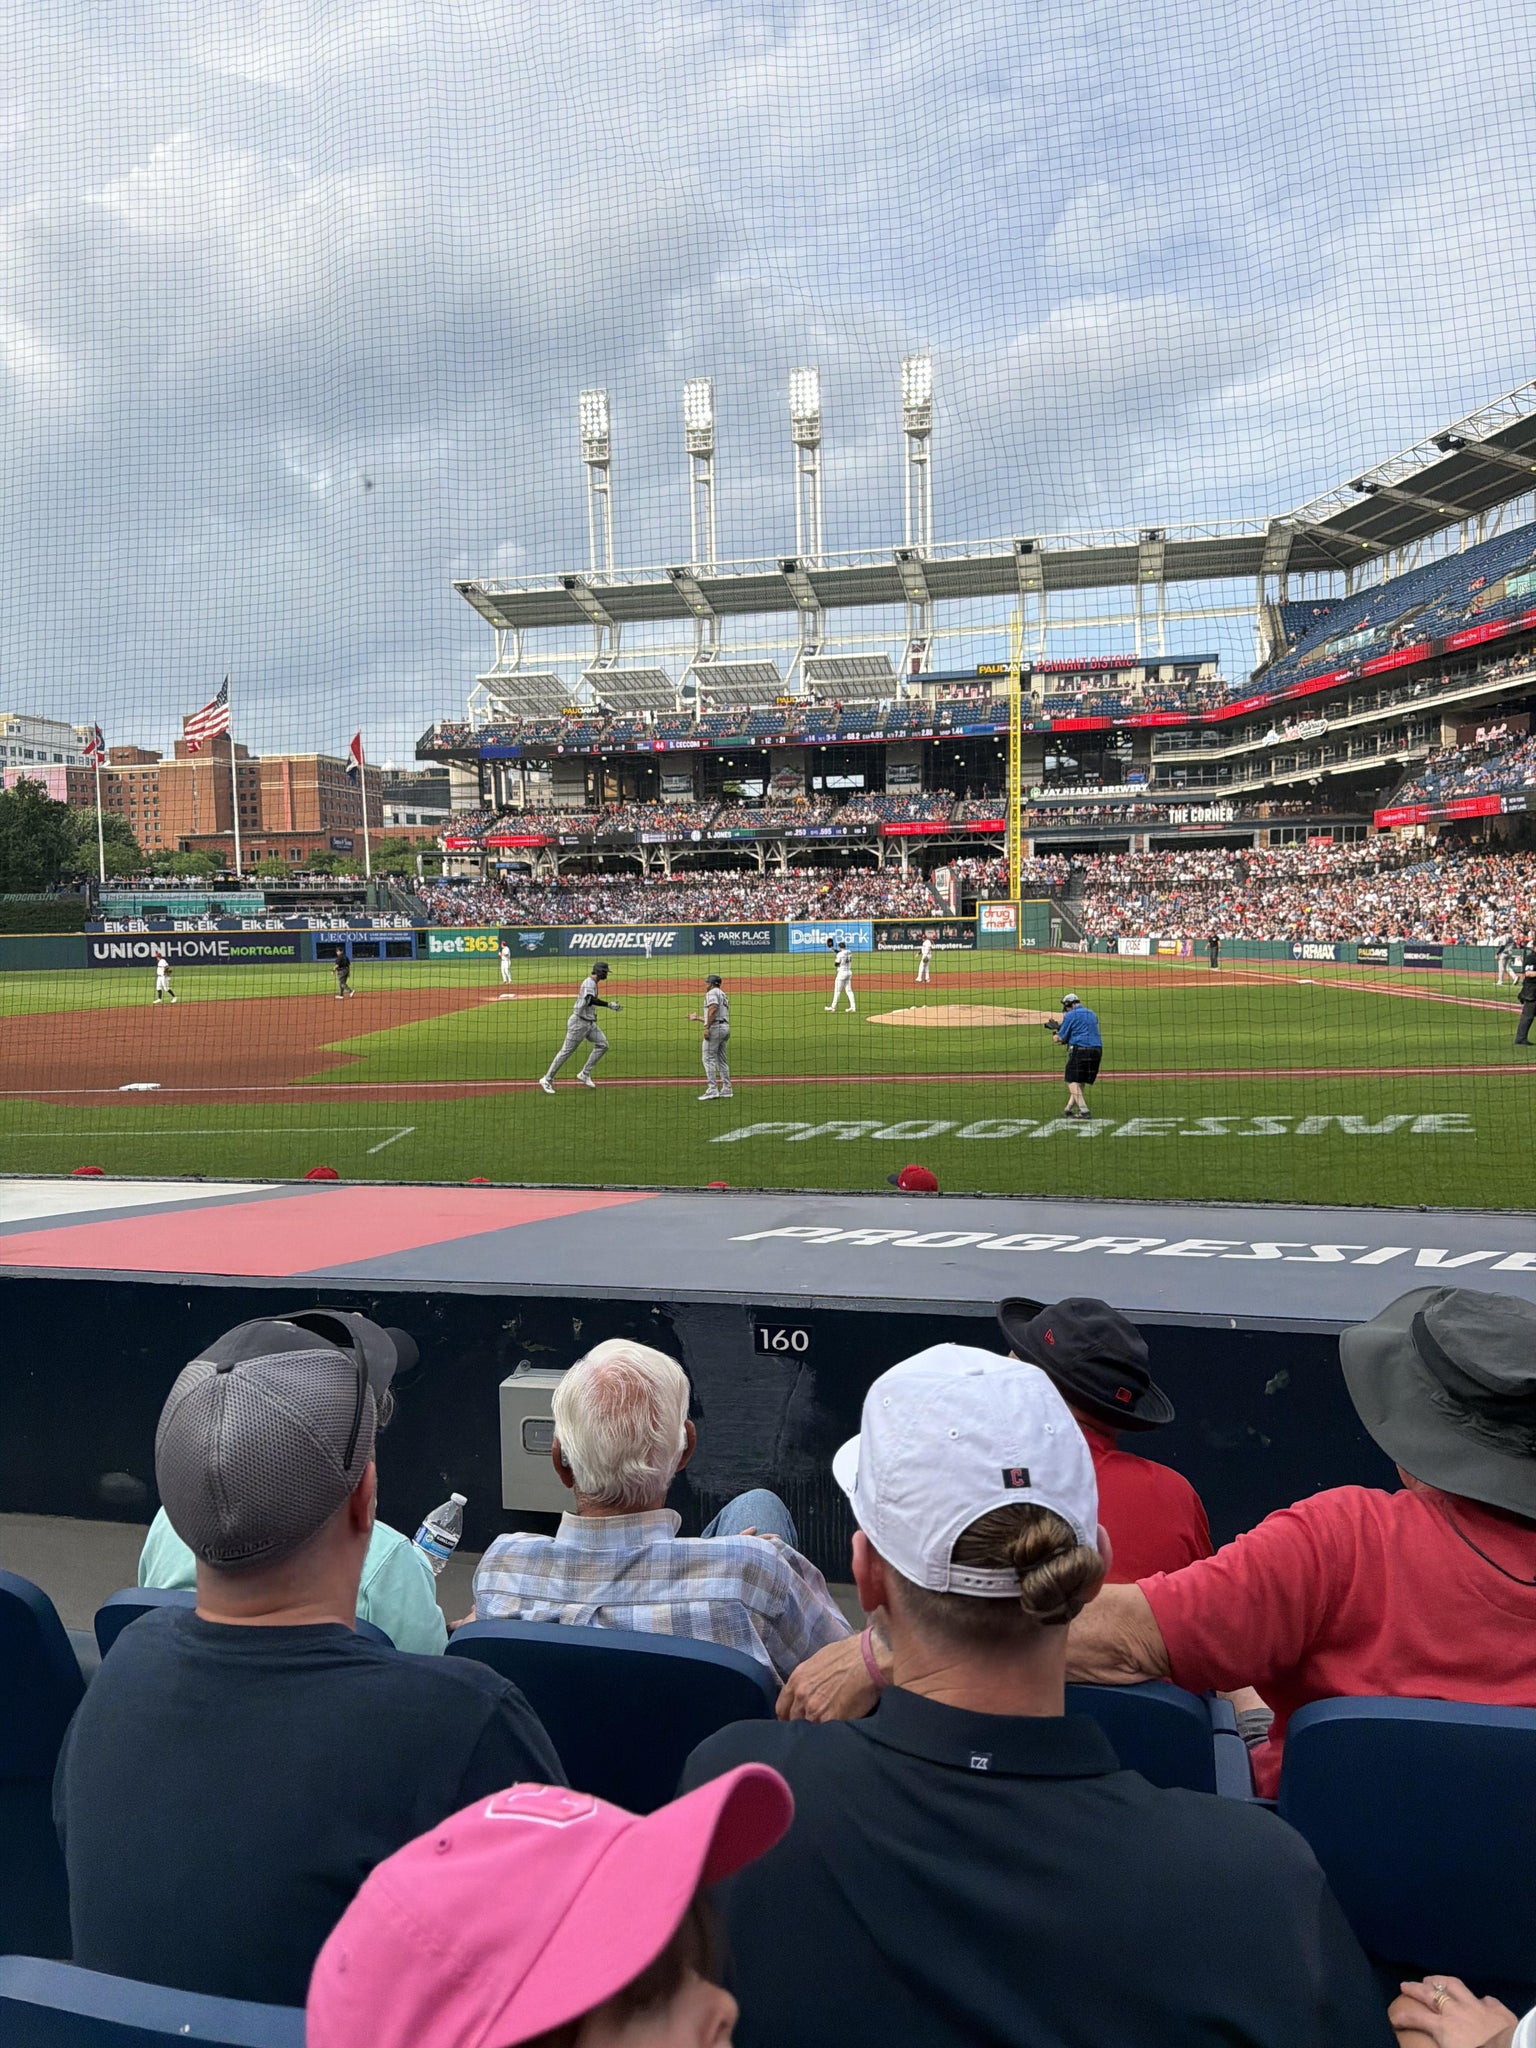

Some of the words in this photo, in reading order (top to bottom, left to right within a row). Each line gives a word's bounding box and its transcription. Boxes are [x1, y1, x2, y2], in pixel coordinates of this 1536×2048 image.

[1036, 656, 1088, 673] PENNANT
[1089, 653, 1139, 670] DISTRICT
[655, 741, 665, 749] 44
[1101, 783, 1148, 794] BREWERY
[1169, 809, 1189, 824] THE
[1190, 807, 1234, 823] CORNER
[713, 831, 732, 839] JONES
[984, 904, 1010, 920] drug
[569, 931, 678, 949] PROGRESSIVE
[718, 931, 741, 940] PARK
[742, 930, 770, 940] PLACE
[1021, 938, 1036, 946] 325
[230, 945, 295, 956] MORTGAGE
[429, 935, 499, 953] bet365
[709, 1113, 1476, 1143] PROGRESSIVE
[760, 1328, 809, 1351] 160
[1010, 1468, 1024, 1486] C
